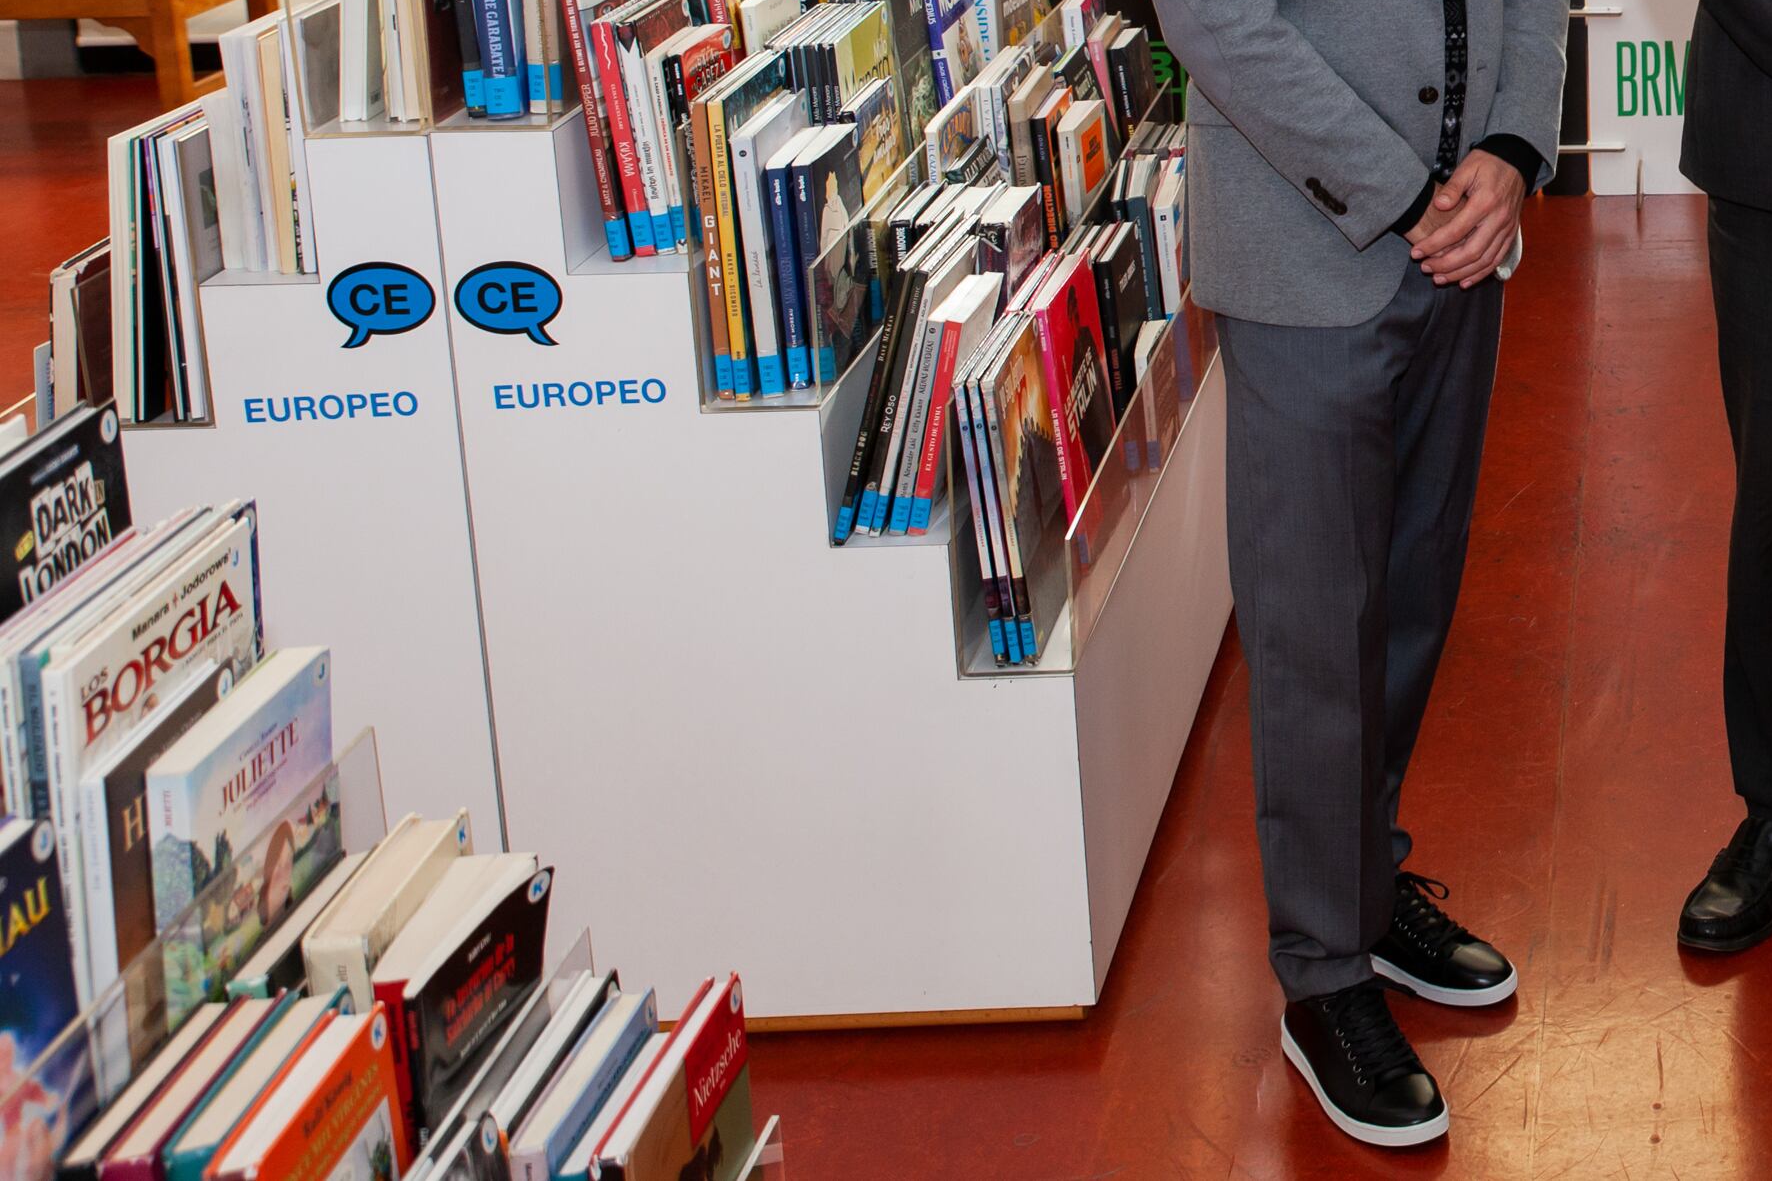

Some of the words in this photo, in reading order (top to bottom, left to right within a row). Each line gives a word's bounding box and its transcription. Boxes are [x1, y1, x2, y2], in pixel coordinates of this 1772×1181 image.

[581, 84, 596, 115] POPPER
[587, 116, 600, 137] JULIO
[714, 133, 724, 158] PUERTA
[618, 141, 634, 177] KUSAMA
[718, 169, 728, 187] CIELO
[1045, 185, 1056, 233] DIRECTION
[704, 215, 720, 296] GIANT
[897, 227, 907, 249] MOORE
[350, 284, 409, 316] CE
[477, 281, 537, 313] CE
[243, 391, 419, 423] EUROPEO
[494, 379, 667, 410] EUROPEO
[1067, 367, 1098, 443] STALIN
[851, 450, 863, 476] BLACK
[858, 430, 868, 448] DOG
[926, 438, 937, 461] GUSTO
[932, 406, 943, 427] EMMA
[1051, 417, 1063, 445] MUERTE
[1058, 456, 1069, 479] STALIN
[36, 467, 93, 542] DARK
[21, 515, 110, 604] LONDON
[132, 598, 170, 641] Manara
[82, 667, 109, 699] LOS
[84, 579, 242, 747] BORGIA
[217, 717, 301, 818] JULIETTE
[694, 1028, 742, 1116] Nietzsche
